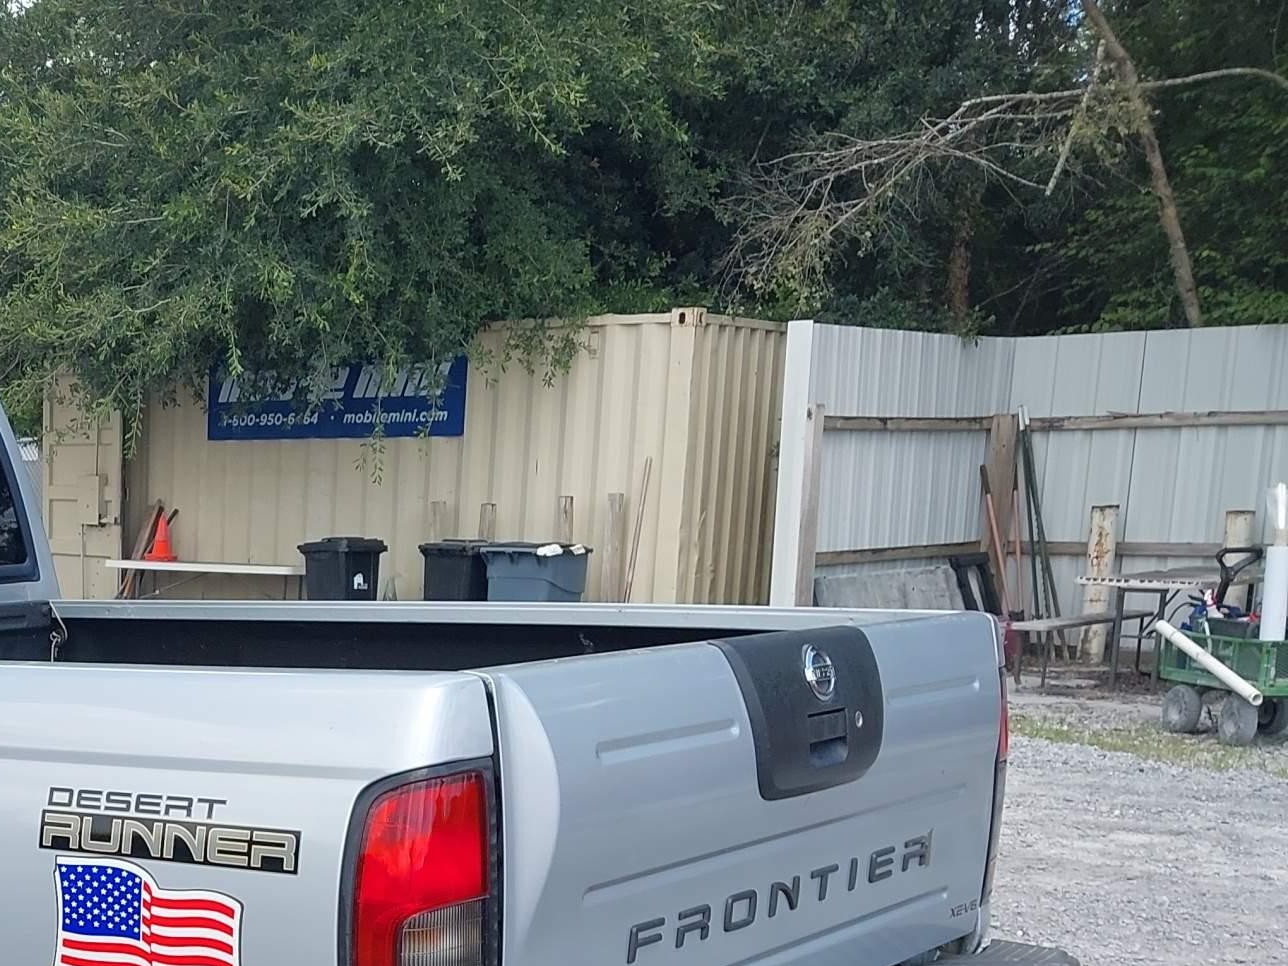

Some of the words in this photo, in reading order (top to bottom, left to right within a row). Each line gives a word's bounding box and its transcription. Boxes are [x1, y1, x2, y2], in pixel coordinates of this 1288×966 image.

[48, 786, 227, 819] DESERT
[42, 812, 296, 871] RUNNER
[626, 828, 934, 965] FRONTIER
